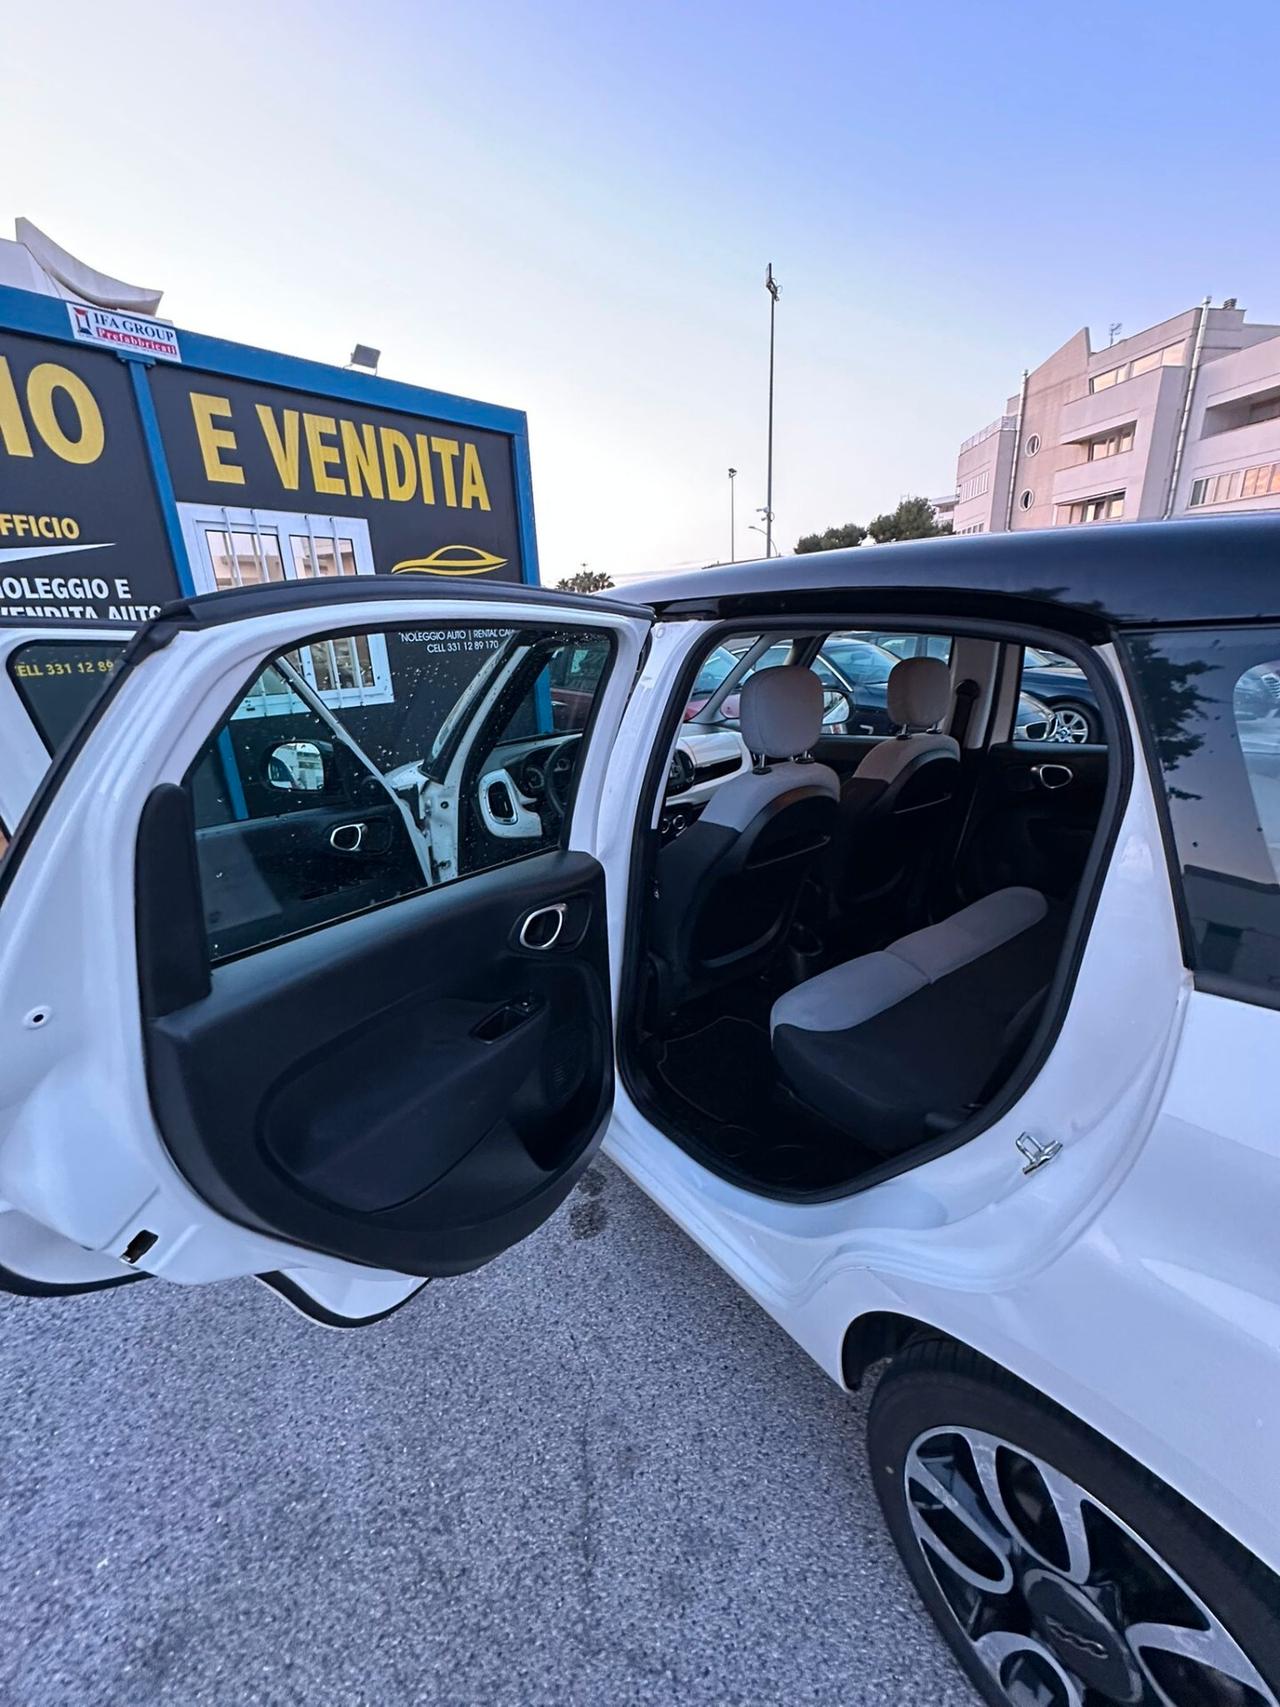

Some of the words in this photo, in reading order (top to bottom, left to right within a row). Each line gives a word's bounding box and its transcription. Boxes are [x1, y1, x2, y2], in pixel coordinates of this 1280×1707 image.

[93, 312, 120, 329] IFA
[122, 320, 174, 341] GROUP
[99, 328, 176, 354] Prefabbricati
[190, 391, 246, 485] E
[255, 403, 492, 512] VENDITA
[0, 577, 109, 600] OLEGGIO
[114, 578, 132, 599] E
[401, 631, 445, 642] NOLEGGIO
[446, 629, 466, 641] AUTO
[473, 629, 498, 639] RENTAL
[427, 643, 445, 653] CELL
[447, 642, 460, 652] 331
[464, 641, 473, 651] 12
[475, 641, 484, 650] 89
[486, 640, 499, 649] 170
[14, 662, 43, 677] ELL
[46, 663, 72, 675] 331
[77, 661, 95, 673] 12
